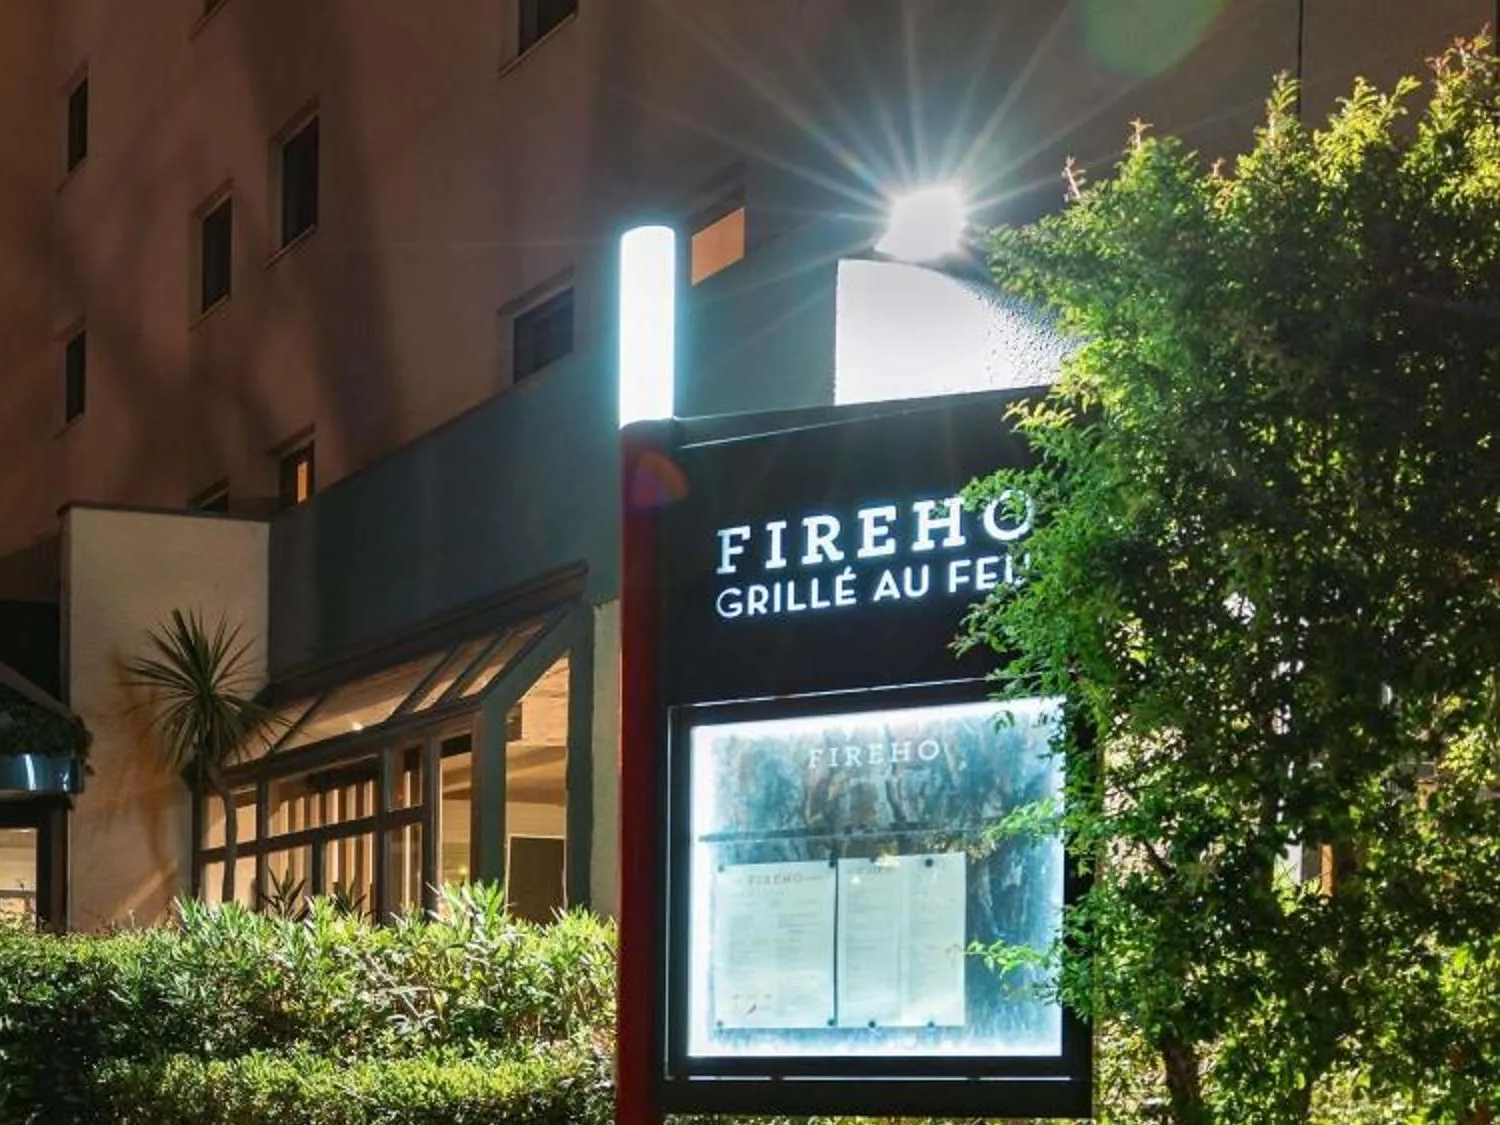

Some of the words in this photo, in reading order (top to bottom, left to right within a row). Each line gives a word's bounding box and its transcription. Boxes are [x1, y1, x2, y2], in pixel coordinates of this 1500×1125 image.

[716, 489, 1033, 574] FIREHO
[716, 566, 857, 618] GRILLÉ
[873, 564, 930, 602] AU
[808, 739, 940, 769] FIREHO
